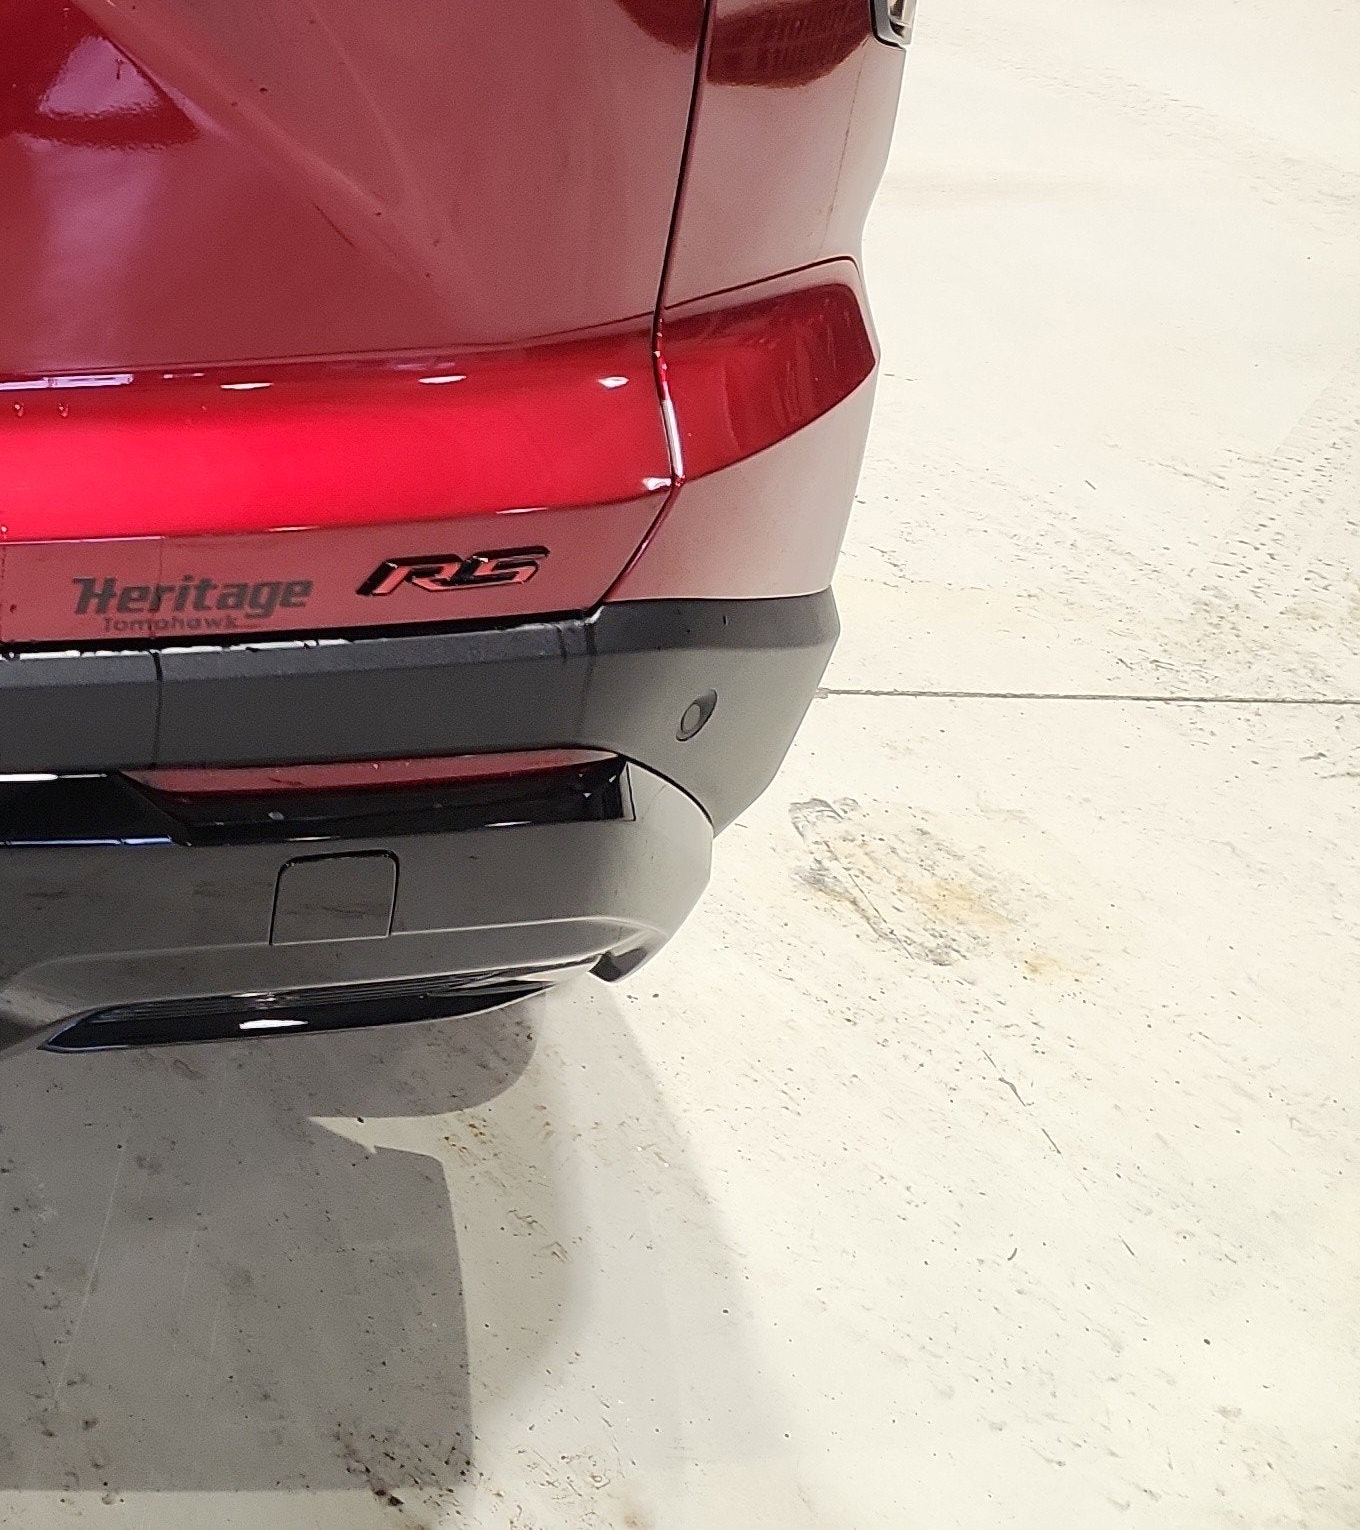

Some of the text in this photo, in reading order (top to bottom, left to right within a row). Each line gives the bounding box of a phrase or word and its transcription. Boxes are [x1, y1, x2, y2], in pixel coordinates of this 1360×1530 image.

[356, 545, 551, 594] RS
[72, 575, 313, 620] Heritage
[103, 613, 238, 633] Tomahawk
